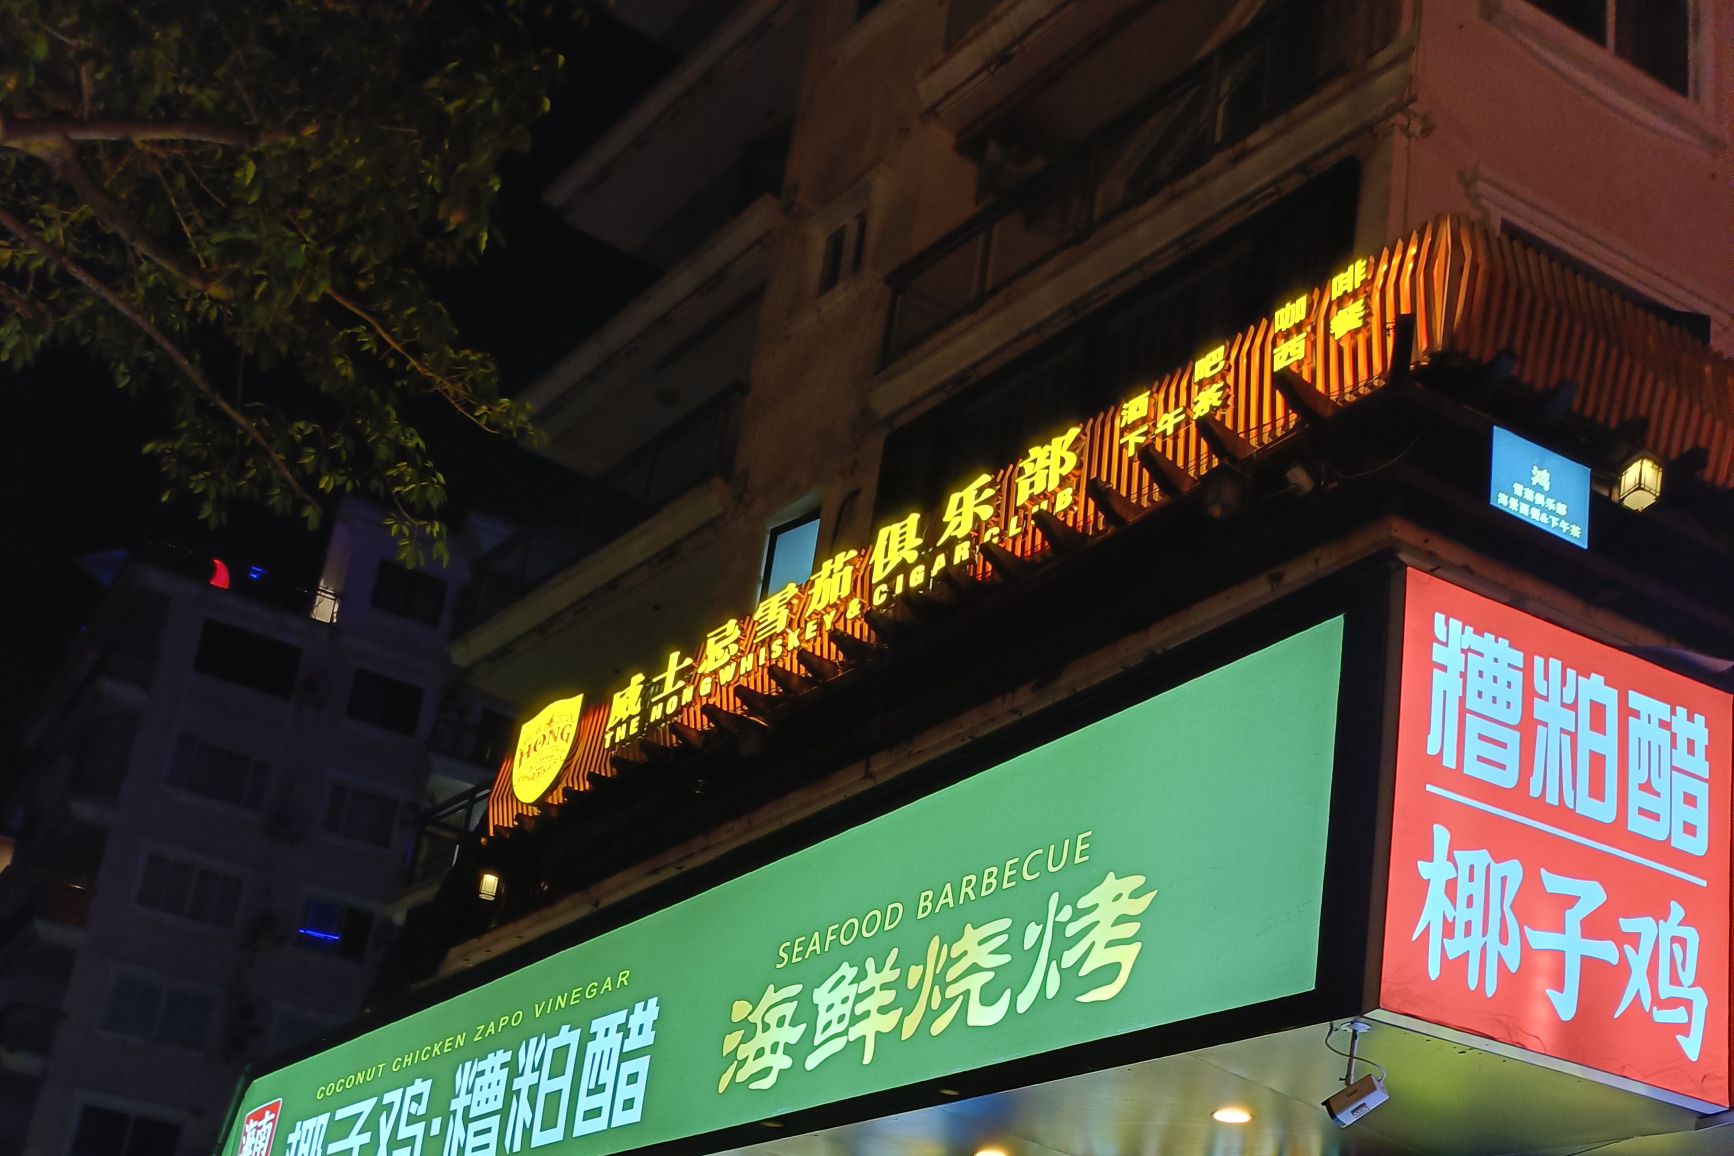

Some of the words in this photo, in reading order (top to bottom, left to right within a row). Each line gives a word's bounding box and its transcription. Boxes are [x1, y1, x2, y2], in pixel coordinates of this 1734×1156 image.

[604, 722, 640, 749] THE
[650, 677, 713, 723] HONG
[719, 610, 836, 685] WHISKEY
[845, 597, 861, 620] &
[872, 541, 972, 607] CIGAR
[606, 427, 1082, 731] 威士忌雪茄俱乐部
[518, 723, 573, 769] HONG
[1426, 611, 1710, 857] 糟粕醋
[718, 871, 1159, 1095] 海鲜烧烤
[775, 902, 905, 970] SEAFOOD
[916, 831, 1093, 920] BARBECUE
[1411, 823, 1709, 1063] 椰子鸡
[316, 1063, 385, 1100] COCONUT
[391, 1032, 467, 1072] CHICKEN
[473, 1010, 524, 1043] ZAPO
[533, 970, 631, 1020] VINEGAR
